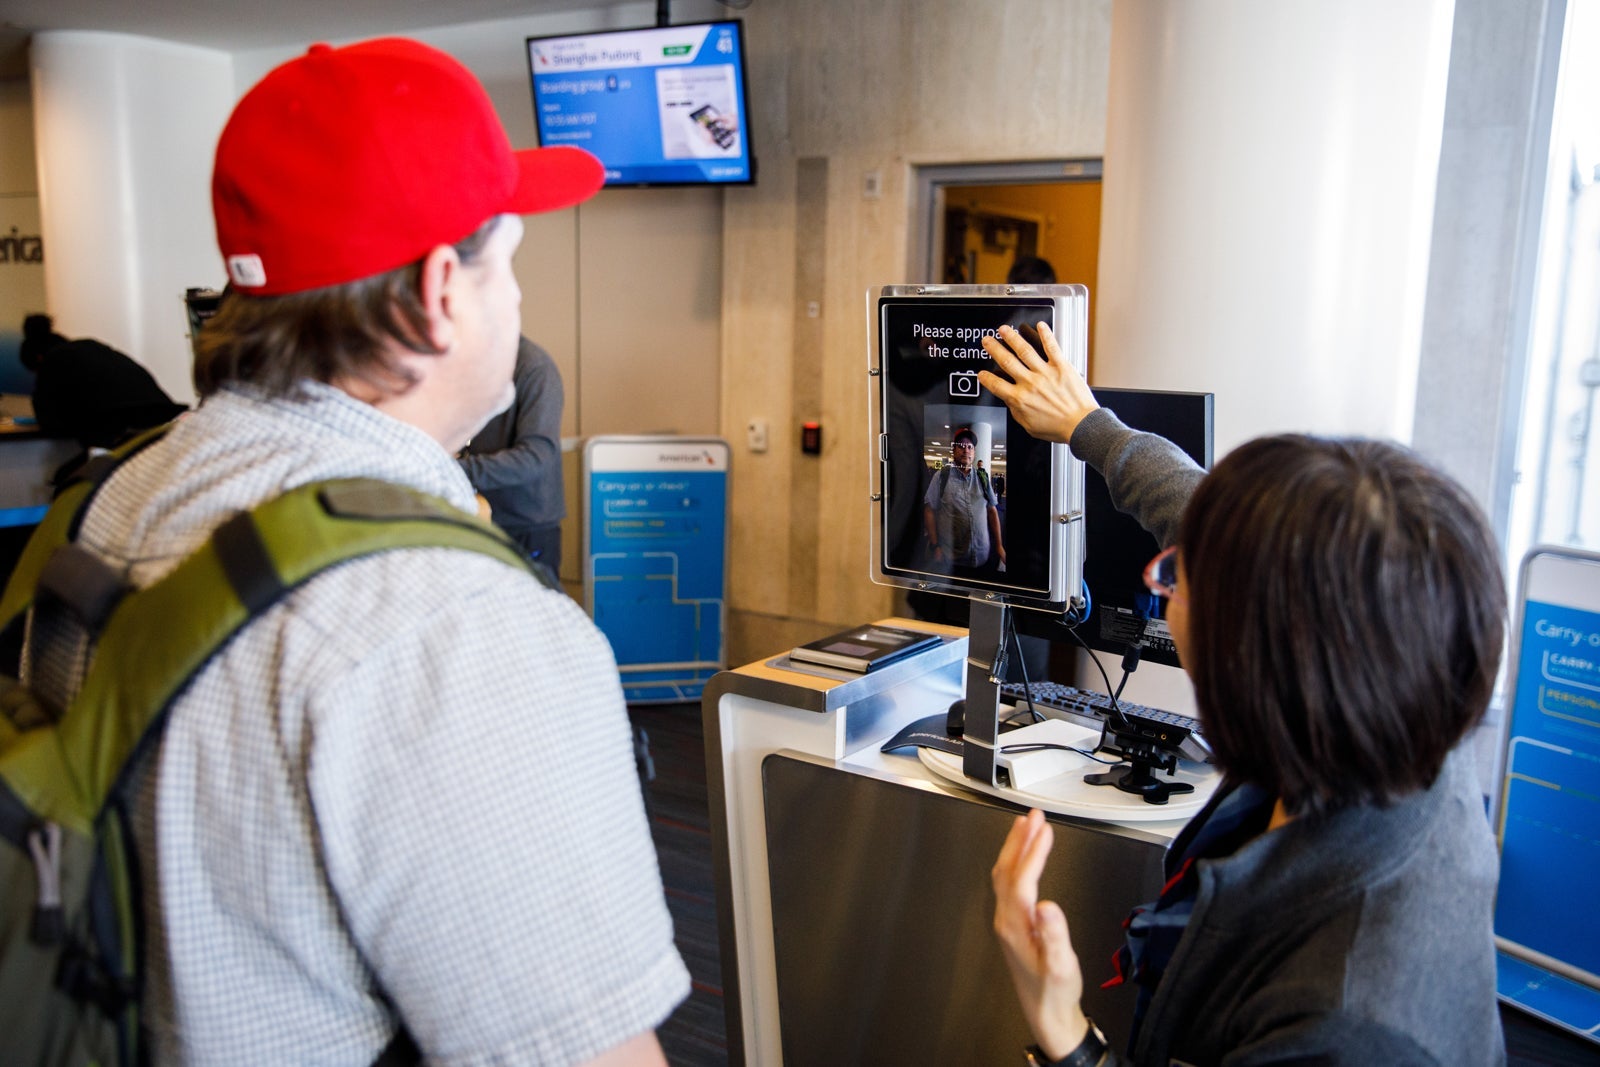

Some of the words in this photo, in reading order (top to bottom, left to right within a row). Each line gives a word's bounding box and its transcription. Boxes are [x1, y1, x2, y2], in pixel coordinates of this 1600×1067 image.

[553, 52, 597, 66] Shanghai
[602, 50, 641, 61] Pudong
[541, 80, 579, 95] Boarding
[913, 323, 953, 338] Please
[956, 325, 1019, 343] approah
[928, 344, 950, 358] the
[952, 347, 992, 359] came
